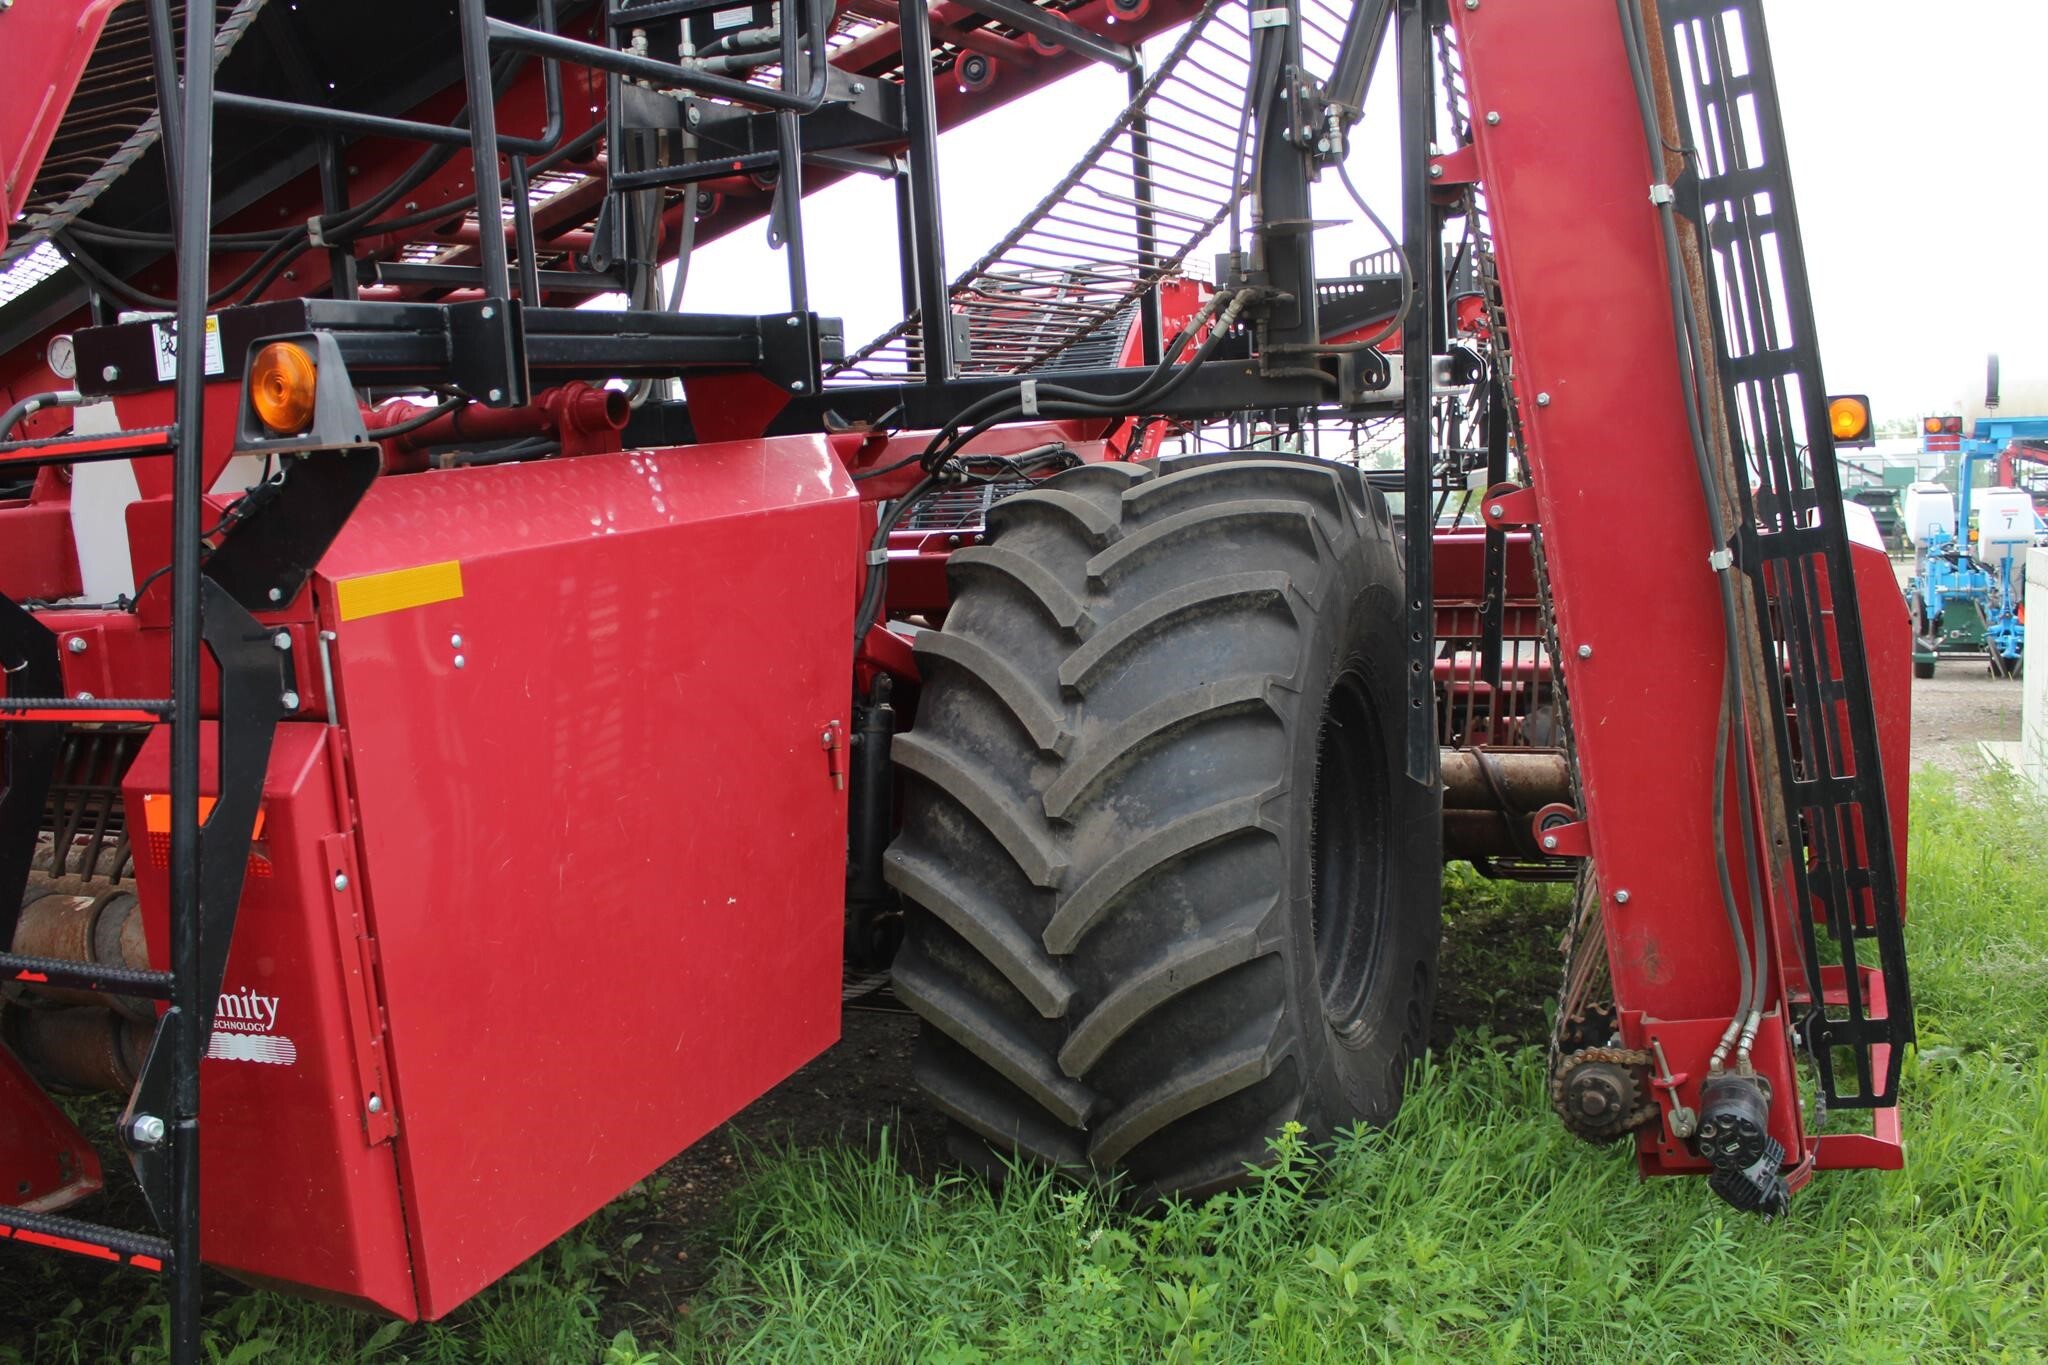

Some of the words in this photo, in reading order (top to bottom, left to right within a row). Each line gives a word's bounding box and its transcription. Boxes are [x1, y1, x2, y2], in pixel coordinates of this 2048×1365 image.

[2006, 517, 2013, 530] 7
[215, 986, 280, 1030] mity
[213, 1020, 265, 1032] ECHNOLOGY
